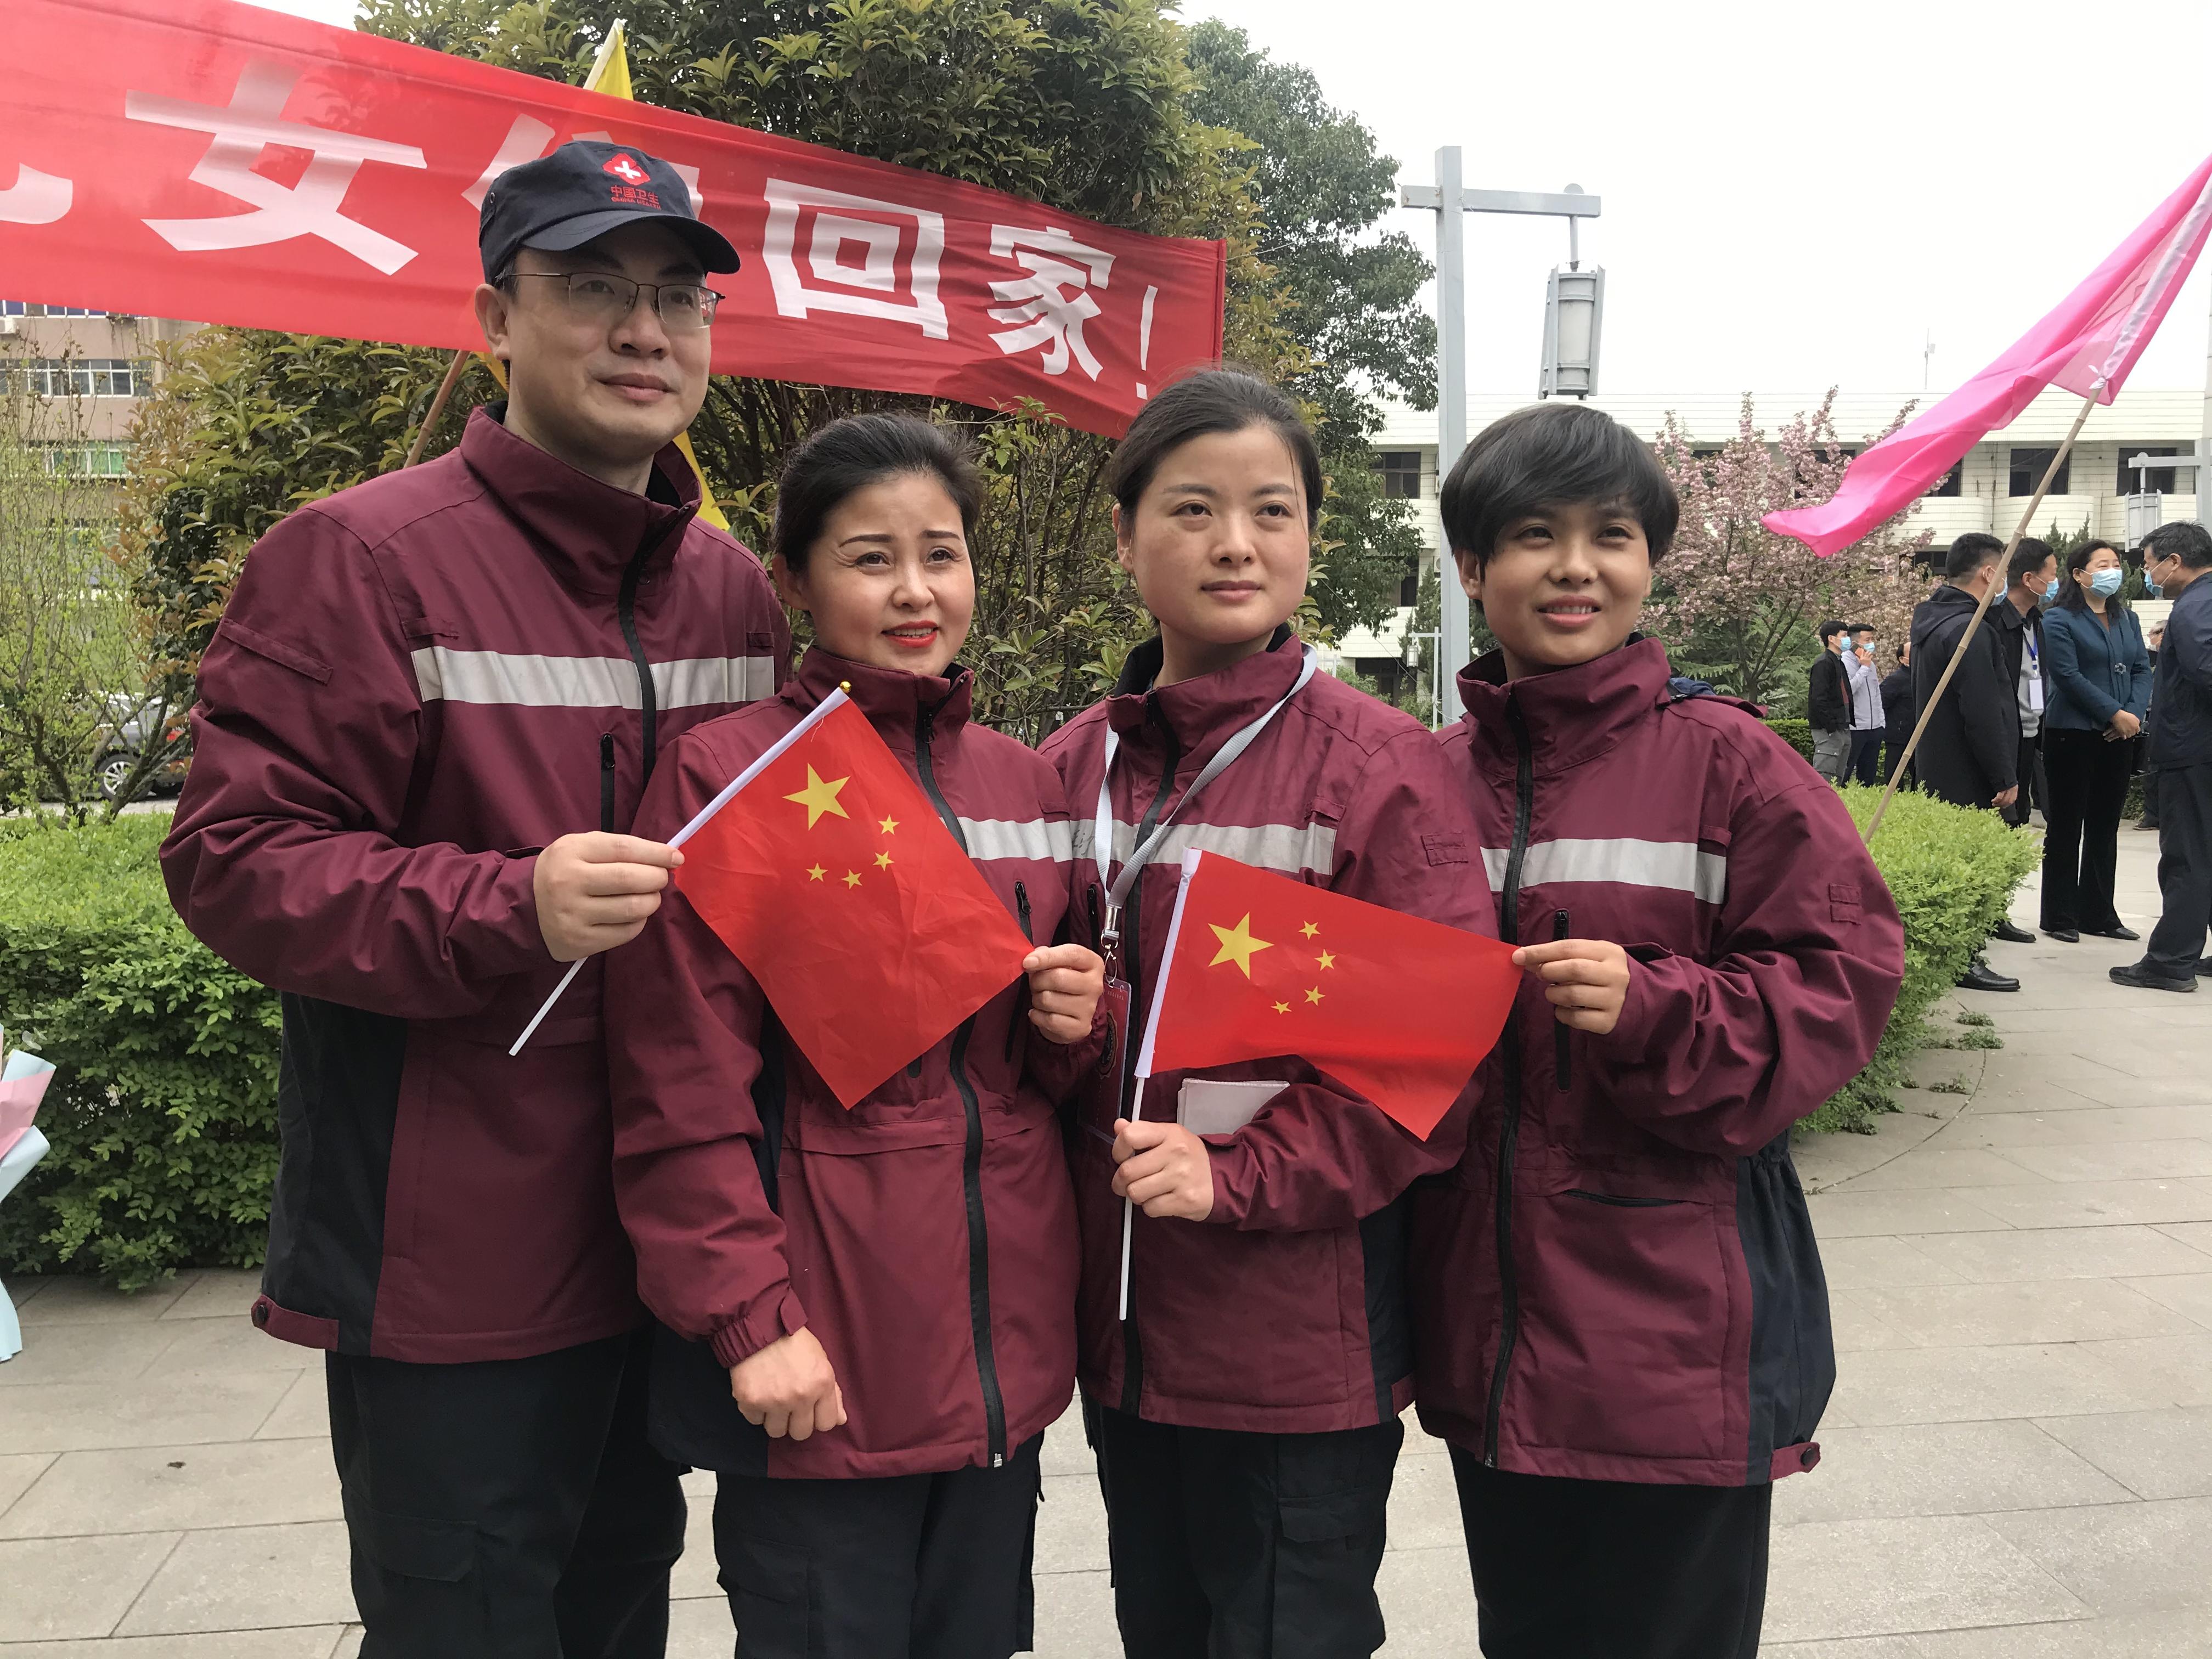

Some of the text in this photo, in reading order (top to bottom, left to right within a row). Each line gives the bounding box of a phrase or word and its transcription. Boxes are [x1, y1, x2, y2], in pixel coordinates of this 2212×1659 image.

[611, 184, 659, 205] 中国卫生
[636, 199, 662, 211] HEALTH
[0, 55, 1158, 399] 女回家!
